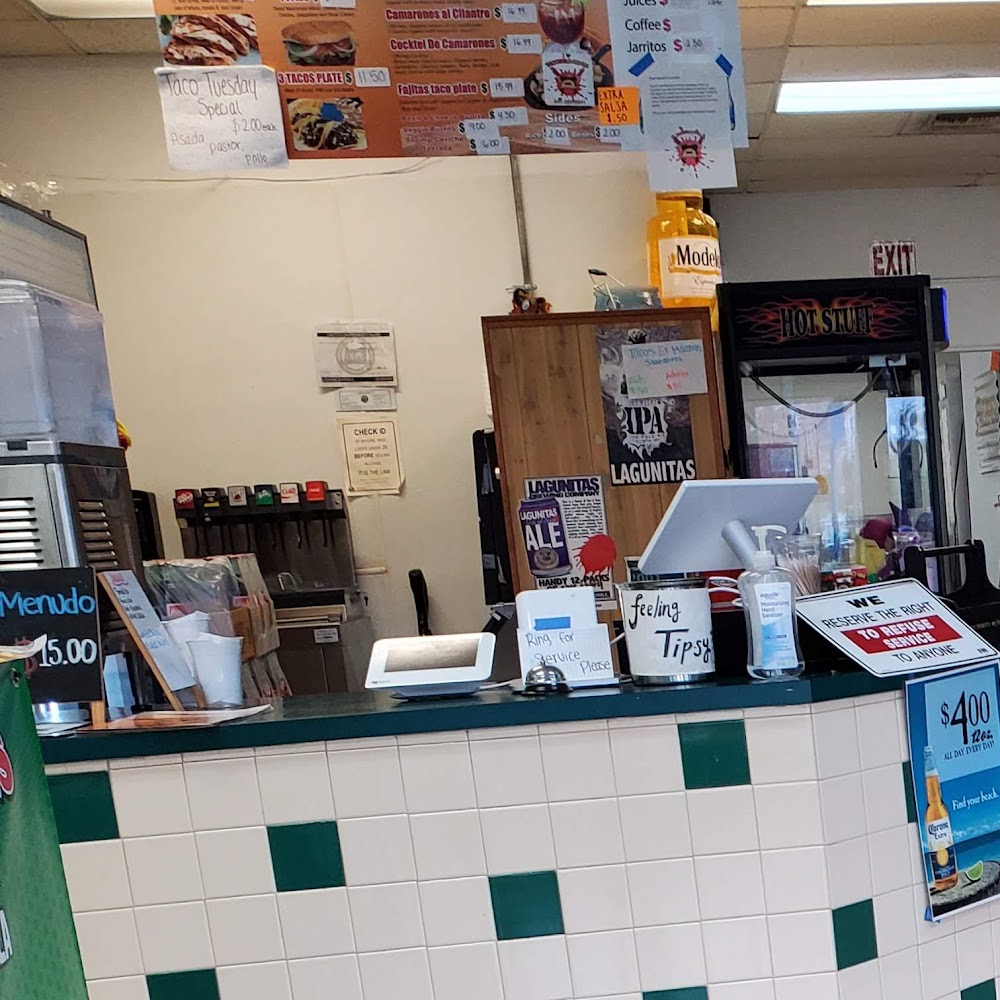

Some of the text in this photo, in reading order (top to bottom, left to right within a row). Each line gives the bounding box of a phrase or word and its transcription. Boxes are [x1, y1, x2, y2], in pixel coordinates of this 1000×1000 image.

[386, 9, 440, 19] Camarones
[442, 8, 450, 18] al
[453, 8, 490, 18] Cilantro
[625, 18, 661, 31] Coffee
[391, 39, 426, 49] Cocktel
[429, 39, 440, 49] De
[443, 38, 495, 49] Camarones
[627, 40, 667, 52] Jarritos
[287, 73, 314, 83] TACOS
[317, 72, 342, 83] PLATE
[159, 71, 257, 100] Taco Tuesday
[398, 84, 428, 95] Fajitas
[431, 84, 451, 94] taco
[453, 83, 477, 95] plate
[599, 90, 624, 100] EXTRA
[197, 98, 242, 120] Special
[600, 101, 628, 113] SALSA
[545, 113, 581, 123] Sides
[872, 244, 914, 275] EXIT
[780, 304, 873, 338] HOT STUFF
[624, 406, 664, 434] IPA
[354, 428, 378, 436] CHECK
[611, 459, 696, 484] LAGUNITAS
[528, 478, 599, 497] LAGUNITAS
[520, 508, 558, 520] LAGUNITAS
[525, 522, 563, 551] ALE
[539, 577, 567, 587] HANDY
[0, 587, 95, 617] Menudo
[846, 595, 885, 609] WE
[628, 594, 681, 630] feeling
[821, 601, 935, 630] RESERVE THE RIGHT
[857, 617, 935, 641] TO REFUSE
[525, 632, 551, 647] Ring
[883, 632, 936, 650] SERVICE
[892, 644, 960, 663] TO ANYONE
[580, 660, 611, 675] Please
[944, 752, 953, 760] ALL
[954, 748, 964, 758] DAY
[952, 796, 966, 811] Find
[967, 796, 980, 809] your
[928, 821, 949, 835] Corona
